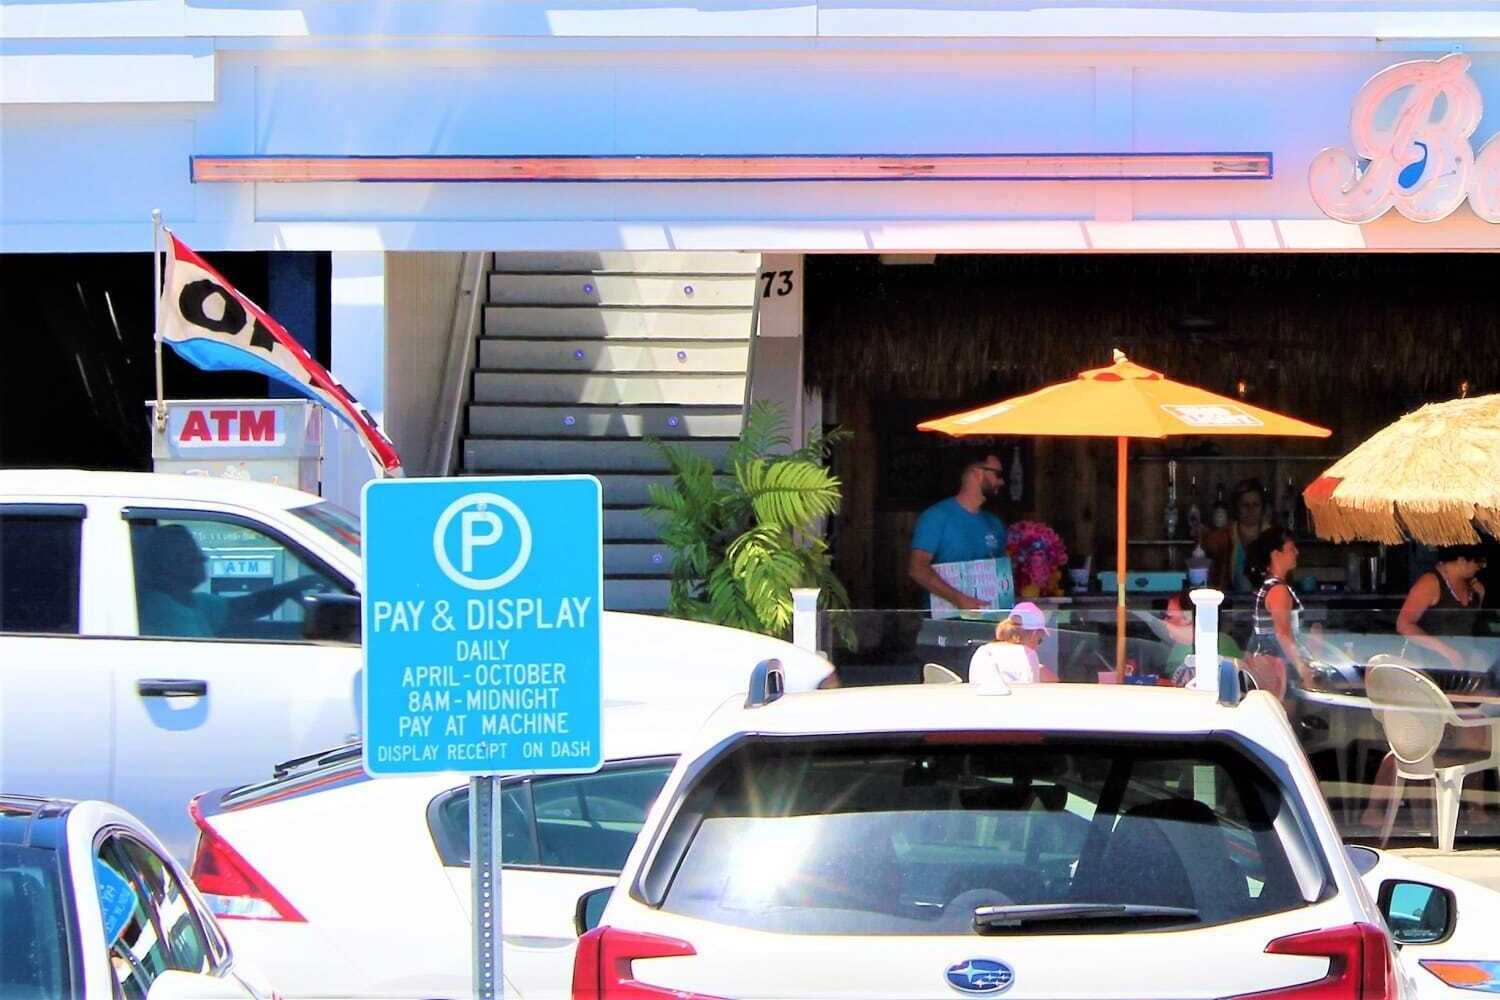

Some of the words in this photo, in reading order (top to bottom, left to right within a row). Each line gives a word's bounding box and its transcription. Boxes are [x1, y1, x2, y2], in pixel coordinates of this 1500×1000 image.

[761, 270, 794, 298] 73
[179, 410, 276, 441] ATM
[225, 560, 259, 574] ATM
[374, 600, 425, 632] PAY
[431, 600, 456, 632] &
[467, 597, 592, 631] DISPLAY
[456, 640, 510, 661] DAILY
[399, 716, 433, 737] PAY
[445, 715, 467, 736] AT
[482, 713, 569, 735] MACHINE
[378, 745, 440, 762] DISPLAY
[447, 743, 508, 760] RECEIPT
[523, 742, 544, 759] ON
[551, 741, 591, 758] DASH
